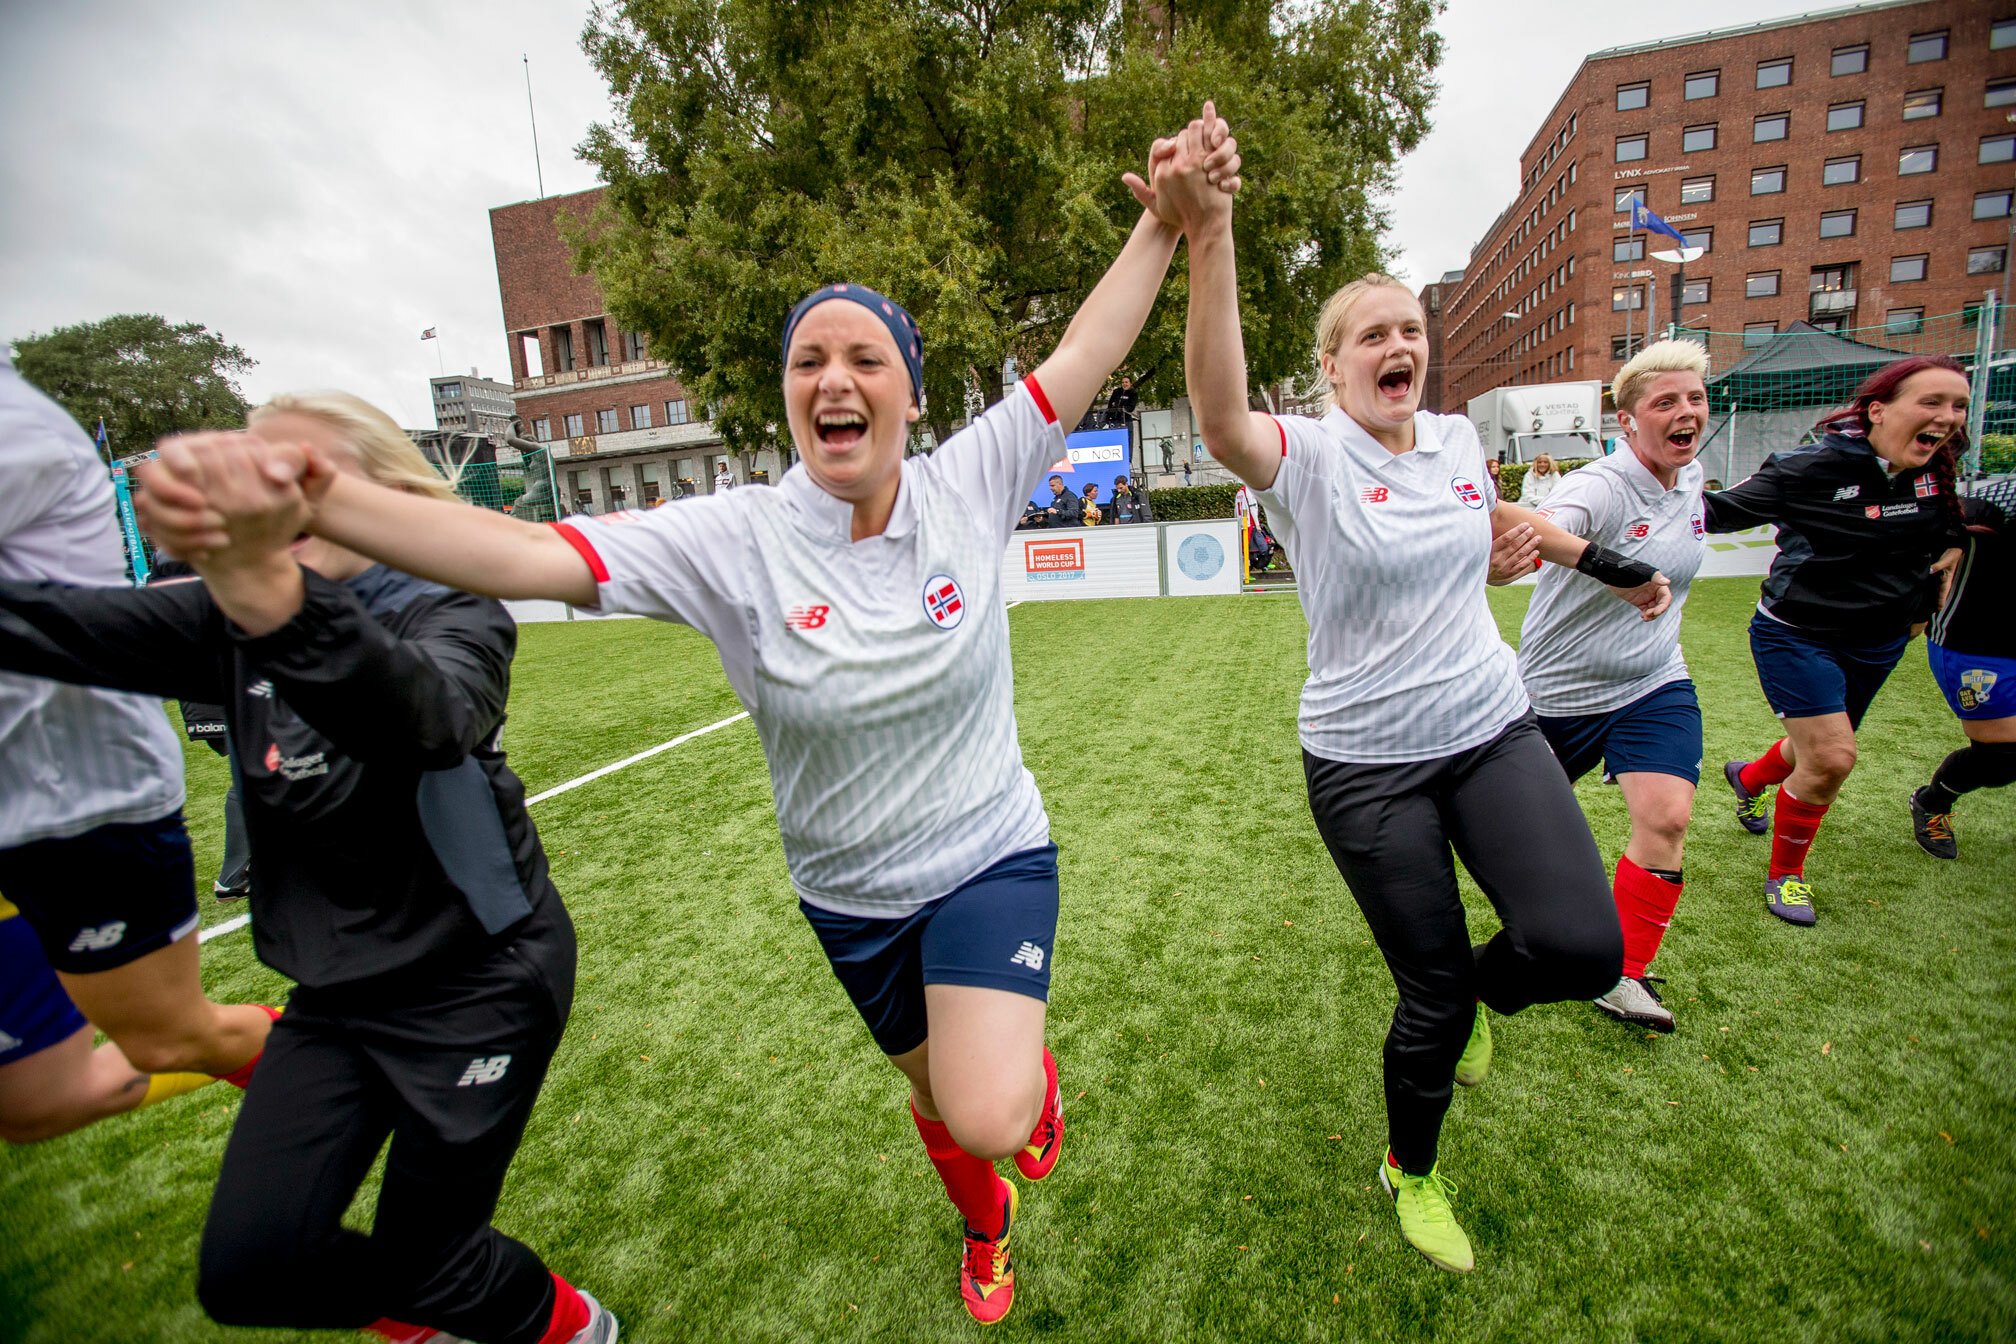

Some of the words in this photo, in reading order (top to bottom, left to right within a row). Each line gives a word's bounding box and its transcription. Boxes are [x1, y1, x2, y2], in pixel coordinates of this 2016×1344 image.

[1614, 168, 1642, 180] LYNX
[1072, 450, 1080, 462] 0
[1093, 449, 1121, 460] NOR
[1035, 553, 1075, 562] HOMELESS
[1036, 561, 1060, 569] WORLD
[1060, 560, 1075, 568] CUP
[1036, 572, 1056, 580] OSLO
[1057, 571, 1075, 579] 2017
